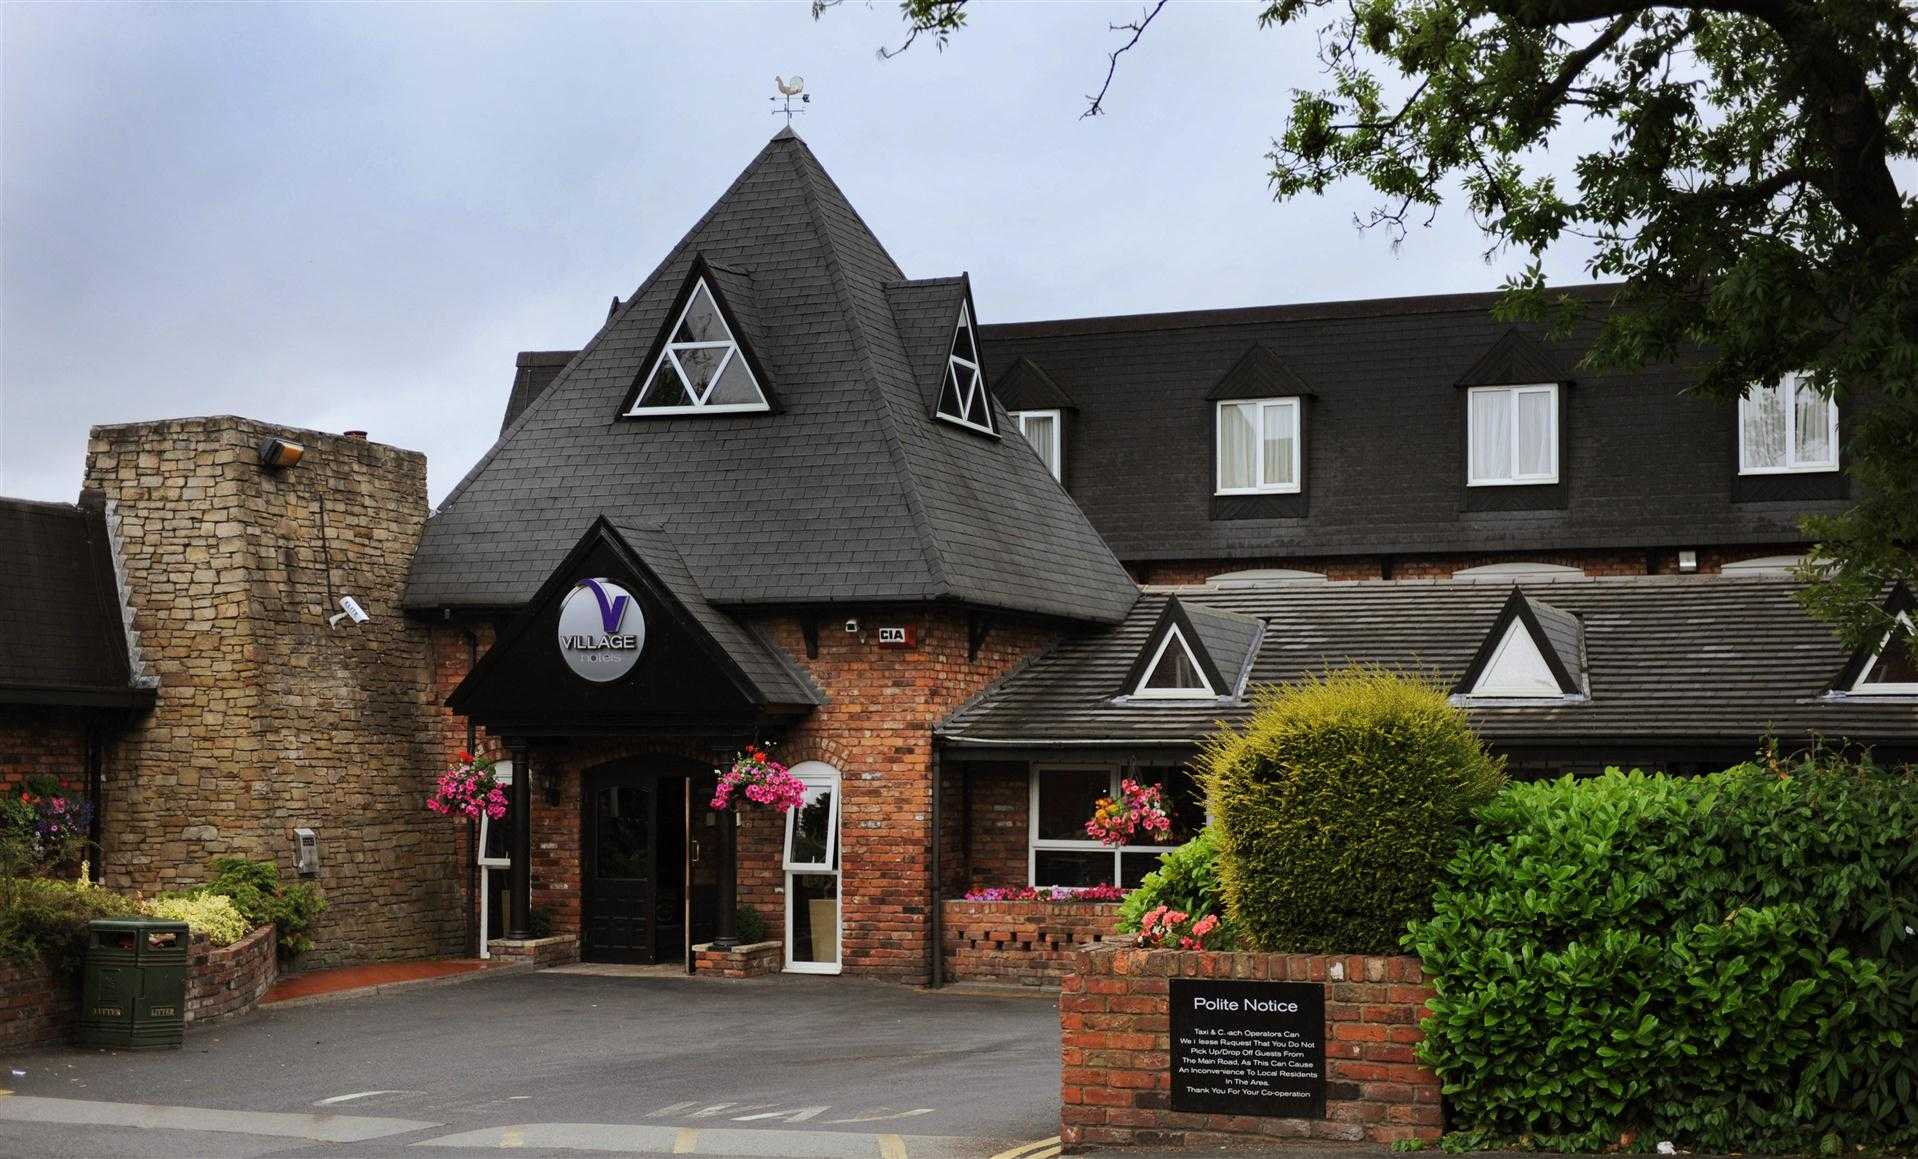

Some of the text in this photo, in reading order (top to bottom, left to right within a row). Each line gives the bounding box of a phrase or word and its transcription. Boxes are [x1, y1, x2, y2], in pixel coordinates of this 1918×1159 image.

[880, 629, 904, 640] CIA
[562, 635, 635, 649] VILLAGE
[1194, 997, 1298, 1012] Polite Notice
[1244, 1030, 1282, 1038] Operators
[1191, 1047, 1207, 1055] Pick
[1209, 1048, 1241, 1056] Up/Drop
[1288, 1060, 1314, 1068] Cause
[1257, 1069, 1278, 1077] Local
[1279, 1070, 1318, 1078] Residents
[1186, 1086, 1210, 1094] Thank
[1260, 1089, 1311, 1098] Co-operation
